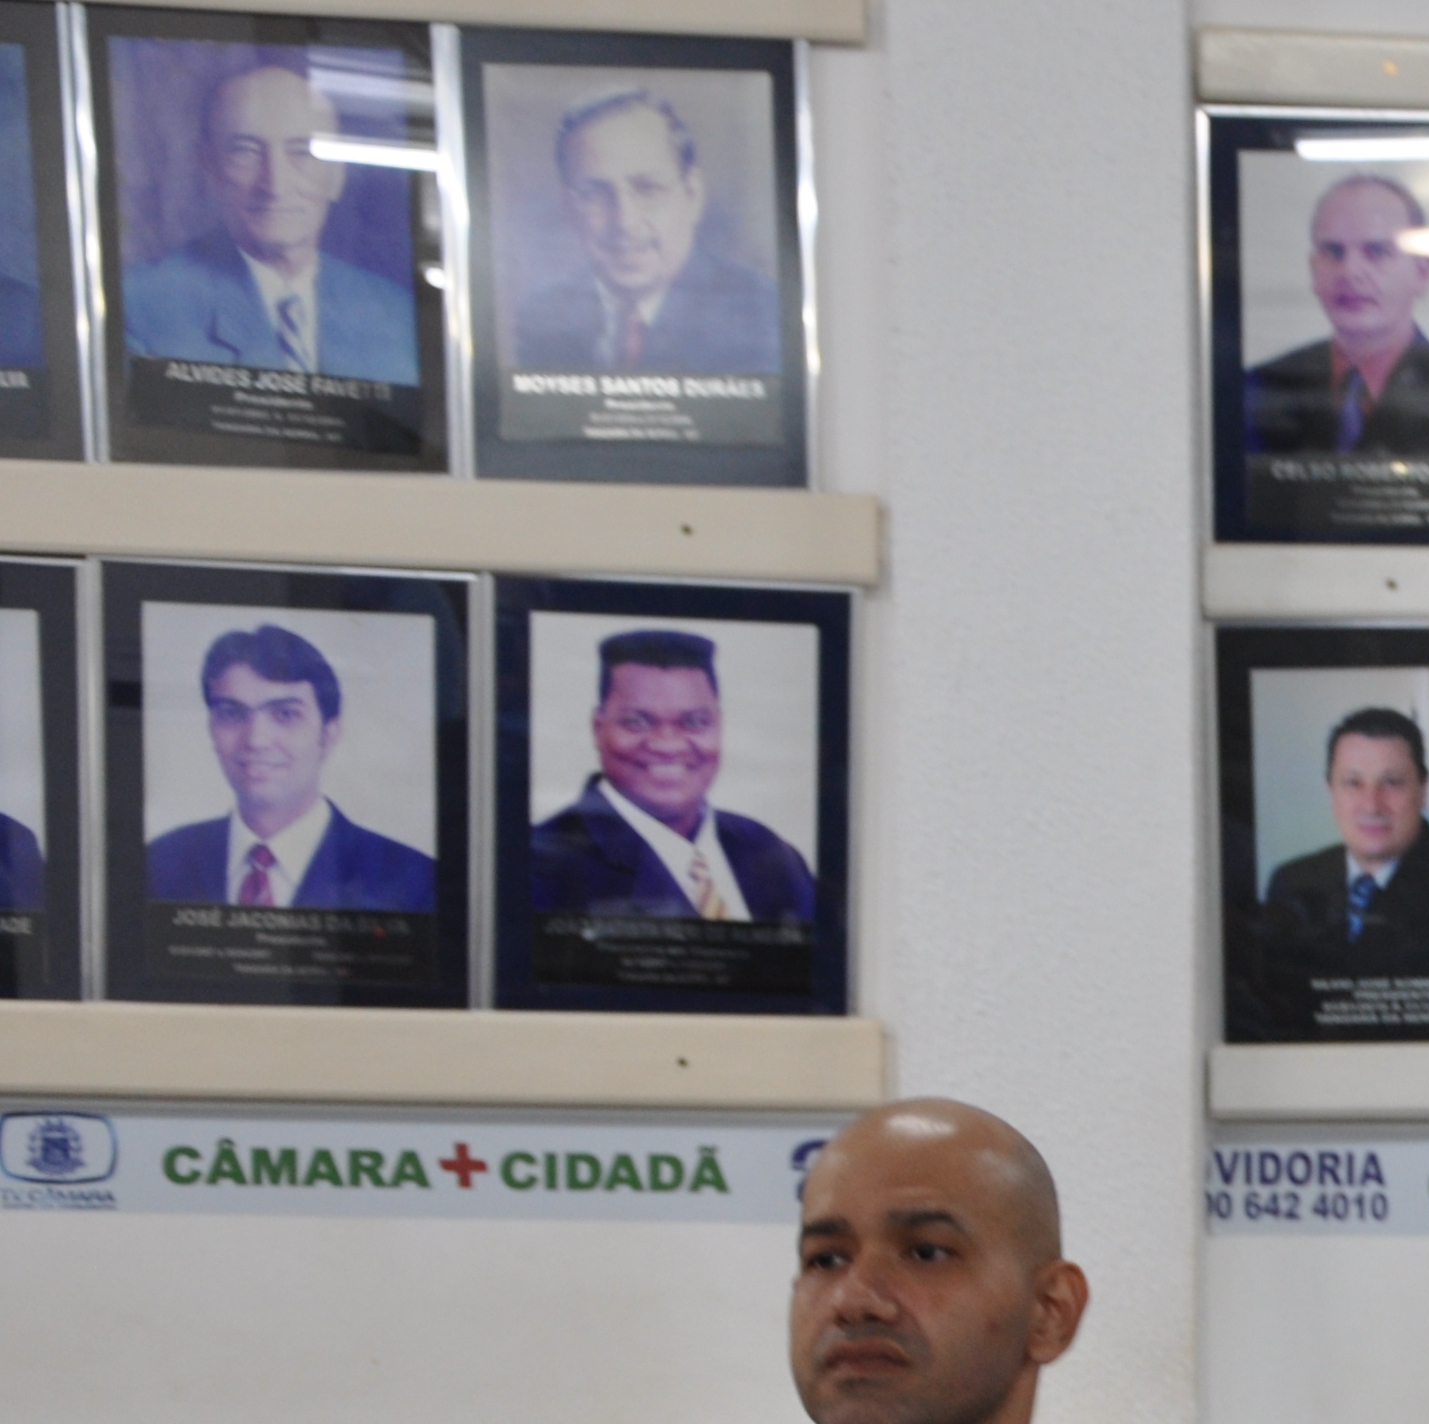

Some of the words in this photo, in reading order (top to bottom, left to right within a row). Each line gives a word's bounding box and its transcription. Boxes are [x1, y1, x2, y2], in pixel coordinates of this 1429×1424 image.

[599, 374, 680, 398] SANTOS
[162, 1136, 431, 1189] CÂMARA
[499, 1145, 730, 1194] CIDADÃ
[1206, 1150, 1386, 1186] VIDORIA
[1244, 1190, 1302, 1221] 642
[1311, 1191, 1390, 1221] 4010
